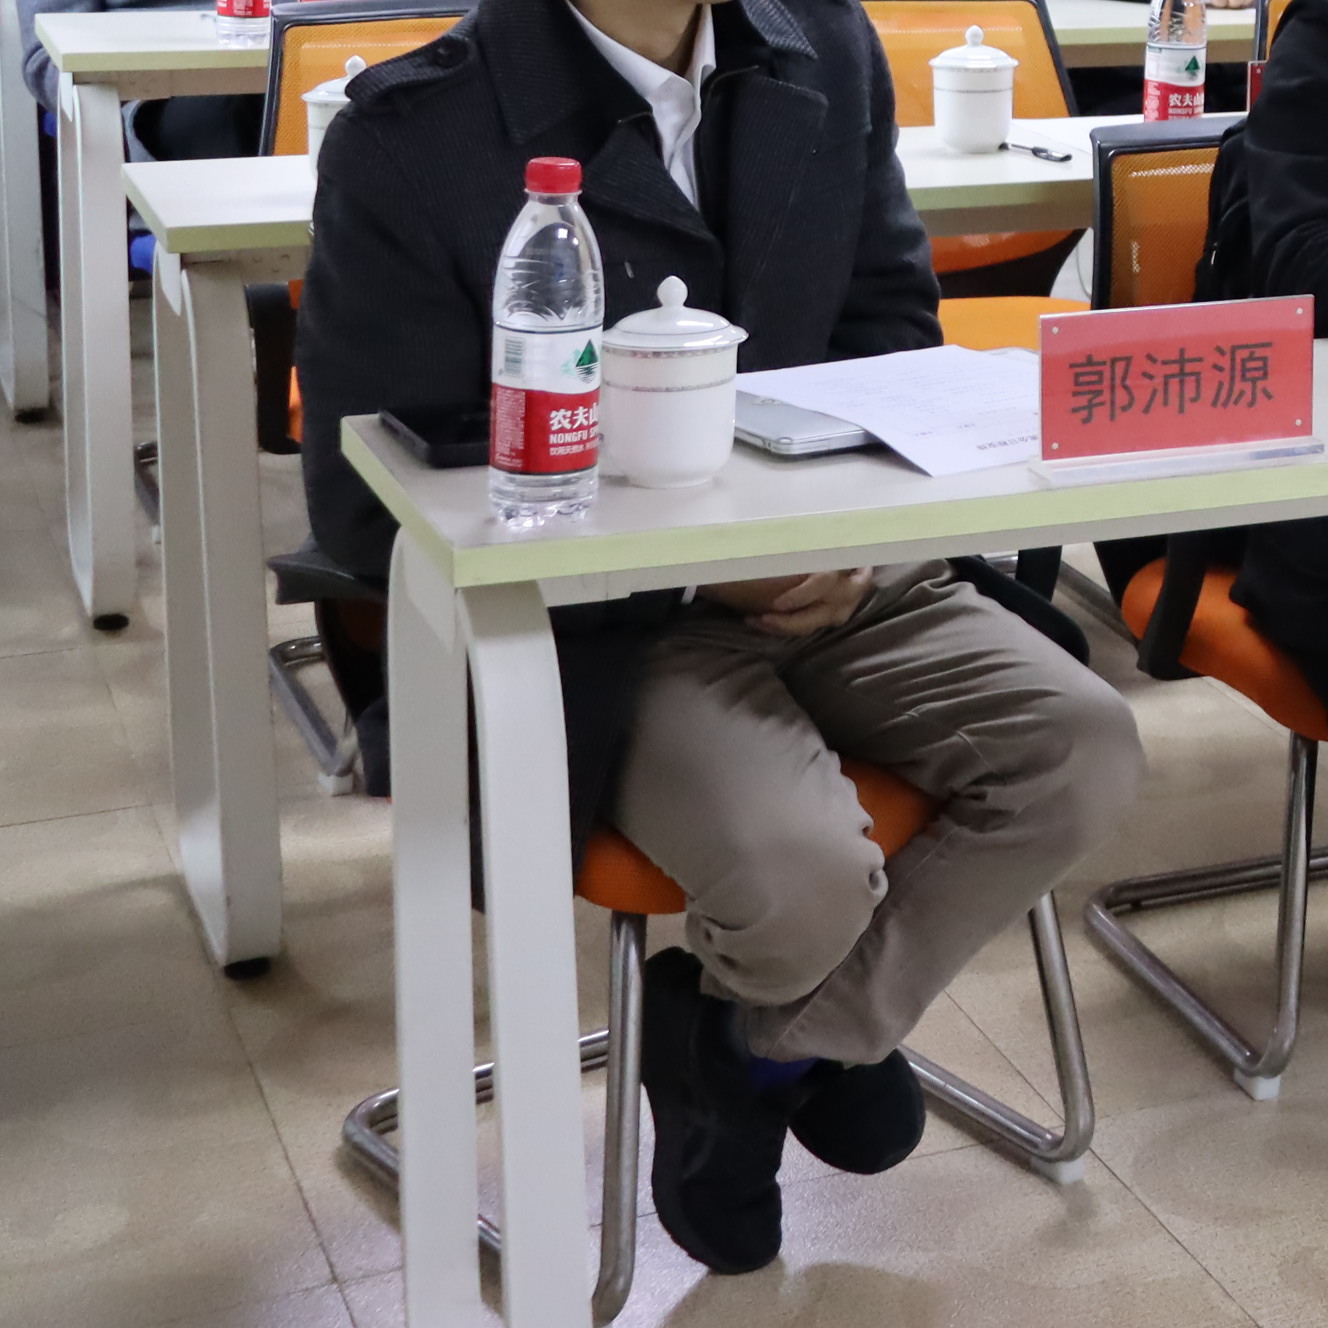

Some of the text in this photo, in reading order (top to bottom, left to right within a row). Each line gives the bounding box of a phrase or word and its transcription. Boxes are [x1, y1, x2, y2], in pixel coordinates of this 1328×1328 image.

[1068, 341, 1274, 424] 郭沛源
[549, 431, 588, 445] NONGFU
